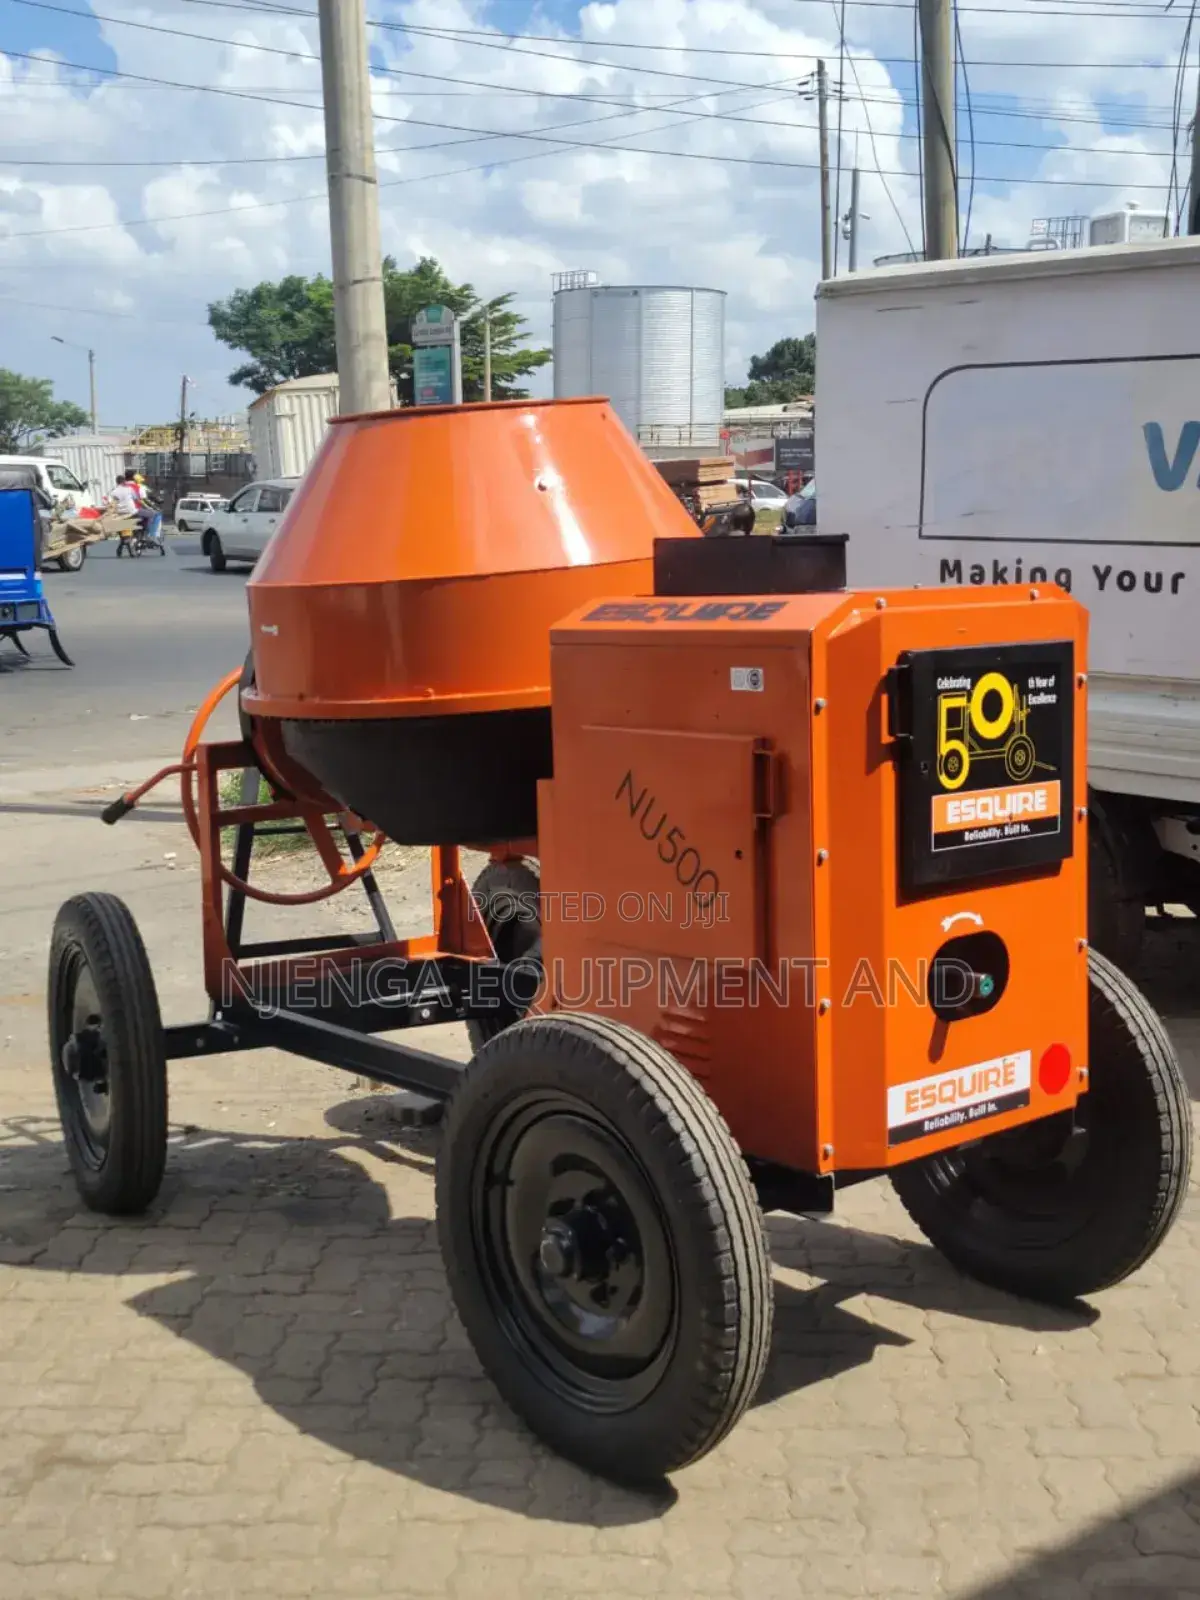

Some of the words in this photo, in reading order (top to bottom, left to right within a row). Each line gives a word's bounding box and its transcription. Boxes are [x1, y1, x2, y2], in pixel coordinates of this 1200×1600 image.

[1142, 421, 1200, 492] V
[939, 558, 1072, 594] Making
[1092, 564, 1186, 595] Your
[580, 601, 788, 623] ESQUIRE
[937, 676, 971, 690] Celebrating
[946, 789, 1048, 825] ESQUIRE
[615, 769, 720, 909] NU500
[905, 1060, 1015, 1115] ESQUIRE
[968, 1104, 986, 1118] Built
